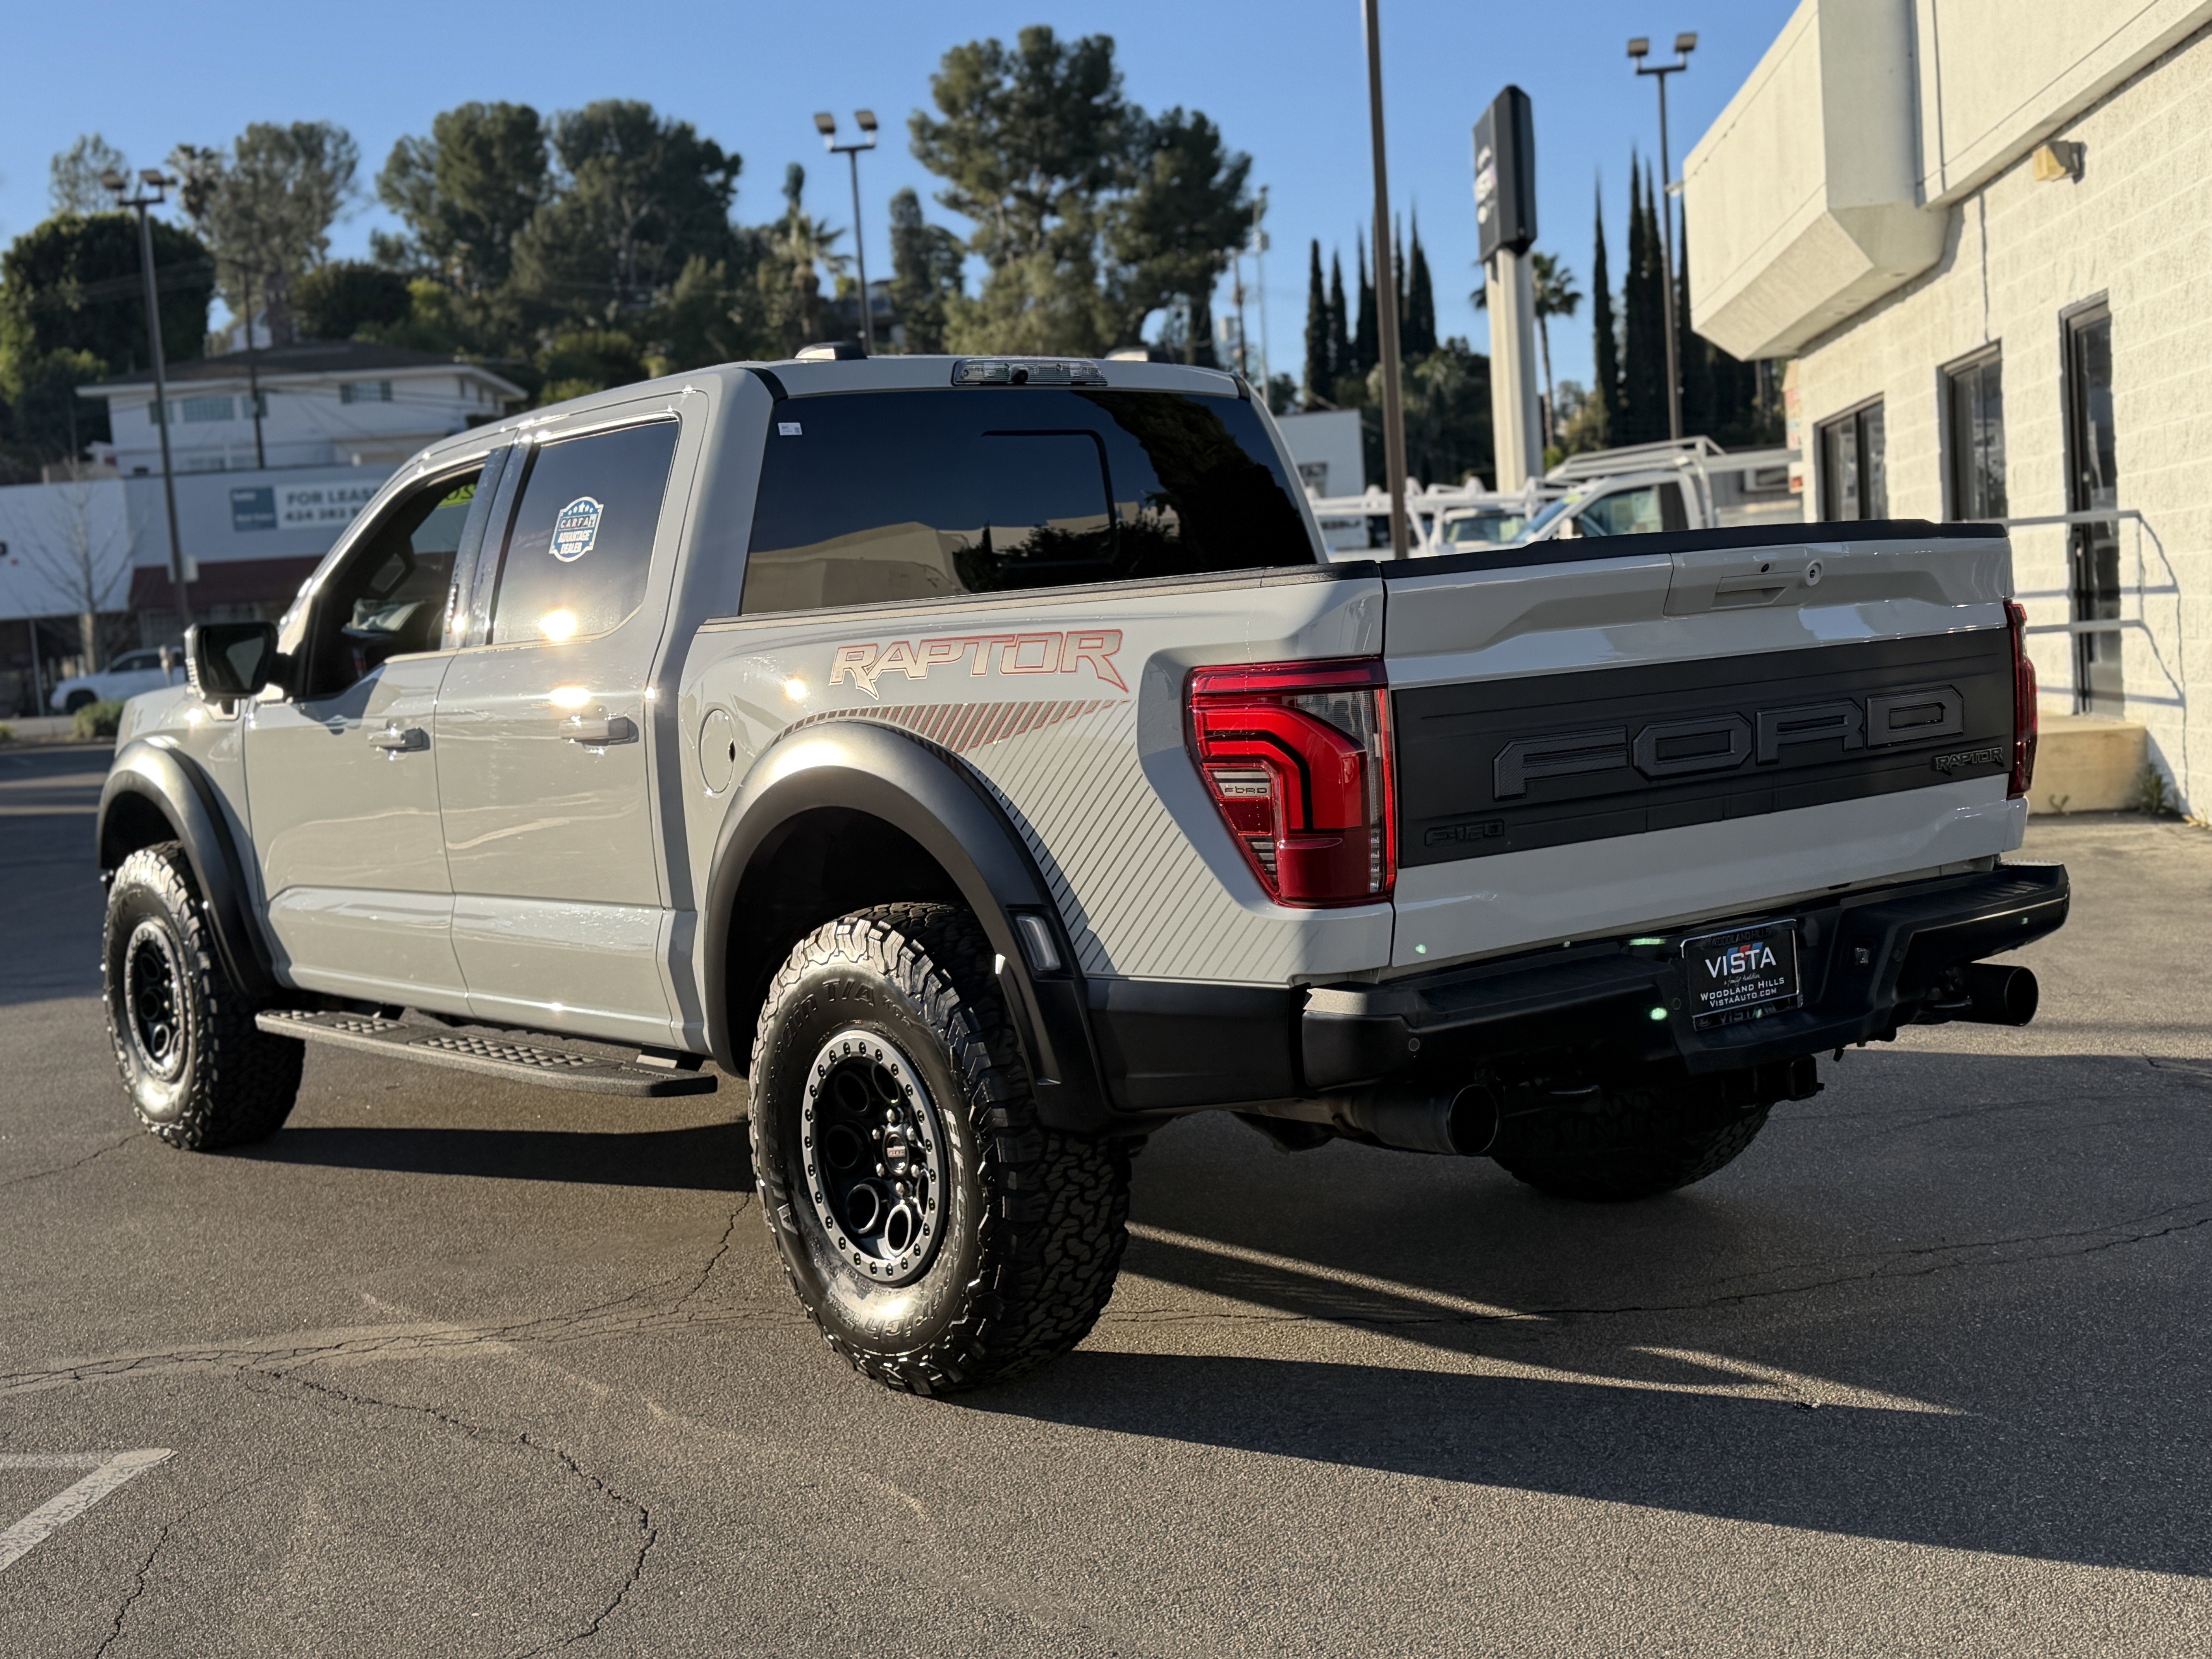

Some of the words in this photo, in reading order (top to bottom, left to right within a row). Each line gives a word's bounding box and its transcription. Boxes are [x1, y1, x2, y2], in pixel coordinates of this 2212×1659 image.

[287, 490, 322, 505] FOR
[560, 516, 596, 528] CARFAX
[828, 629, 1129, 700] RAPTOR
[1492, 685, 1964, 802] FORD
[1935, 747, 2004, 776] RAPTOR
[1224, 785, 1267, 794] FORD
[1705, 947, 1776, 978] VISTA
[823, 978, 875, 1007] T/A
